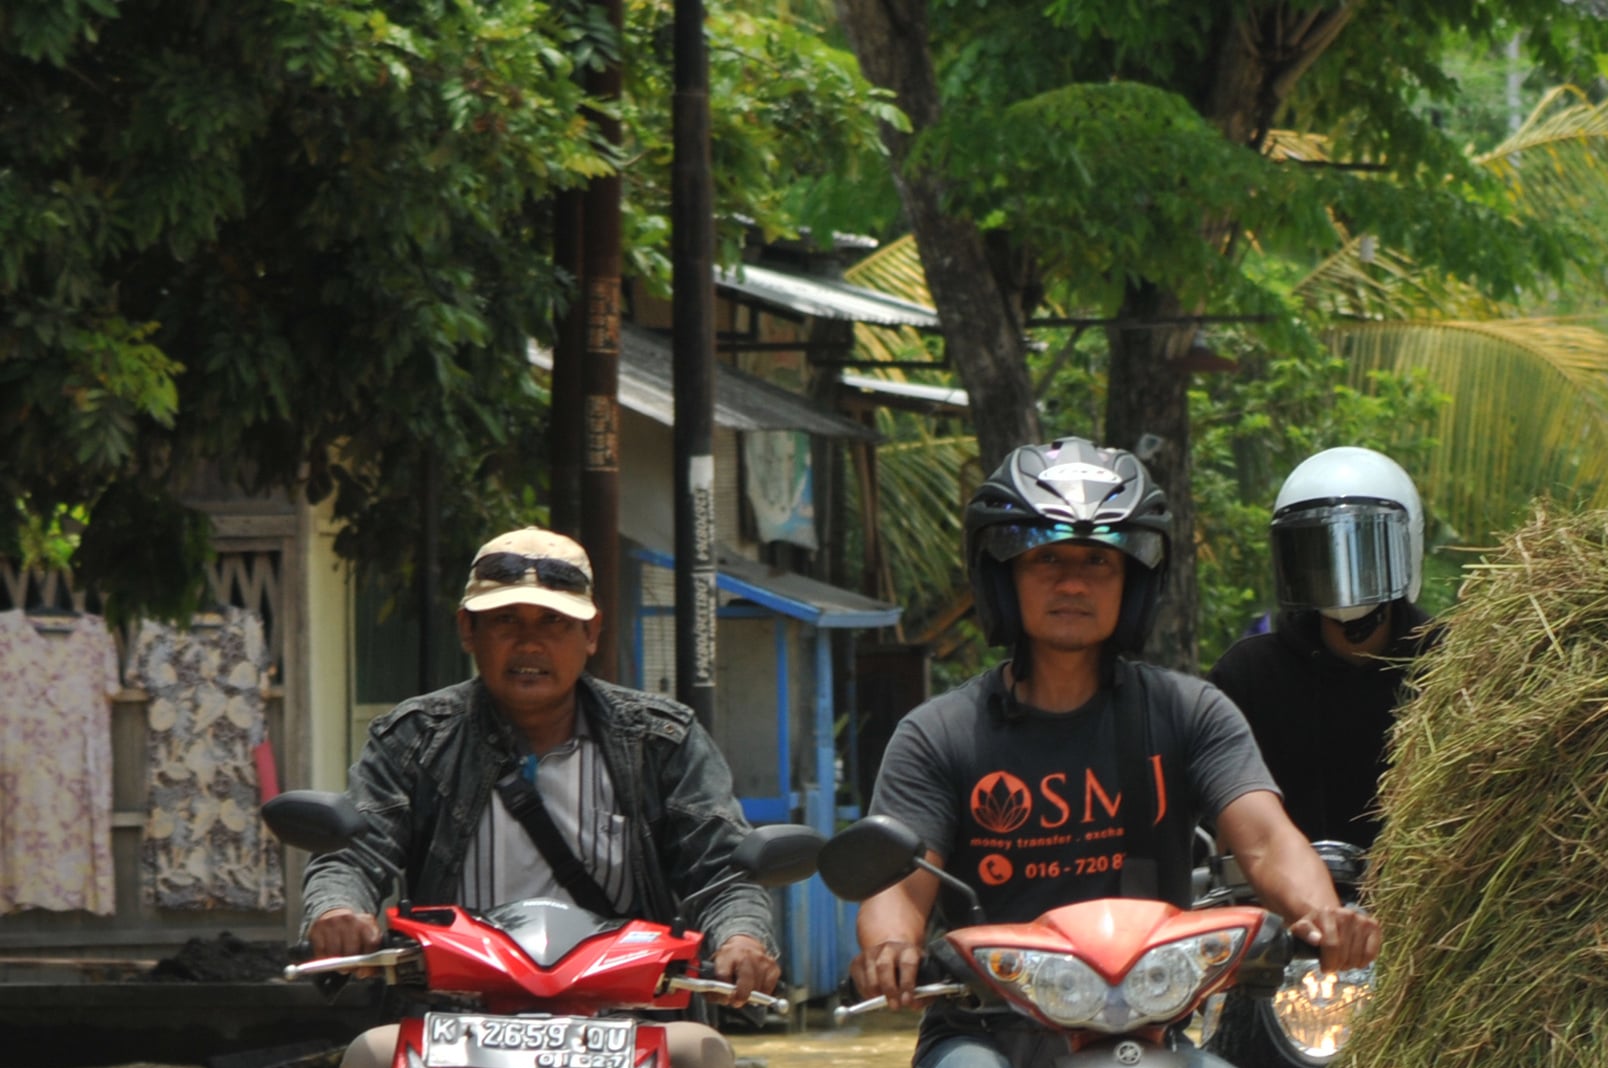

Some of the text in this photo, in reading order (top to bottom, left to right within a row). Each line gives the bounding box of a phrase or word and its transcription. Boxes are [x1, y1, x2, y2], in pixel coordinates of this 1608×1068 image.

[970, 827, 1124, 850] money transfer excha
[433, 1017, 455, 1041] K
[484, 1021, 566, 1049] 2659
